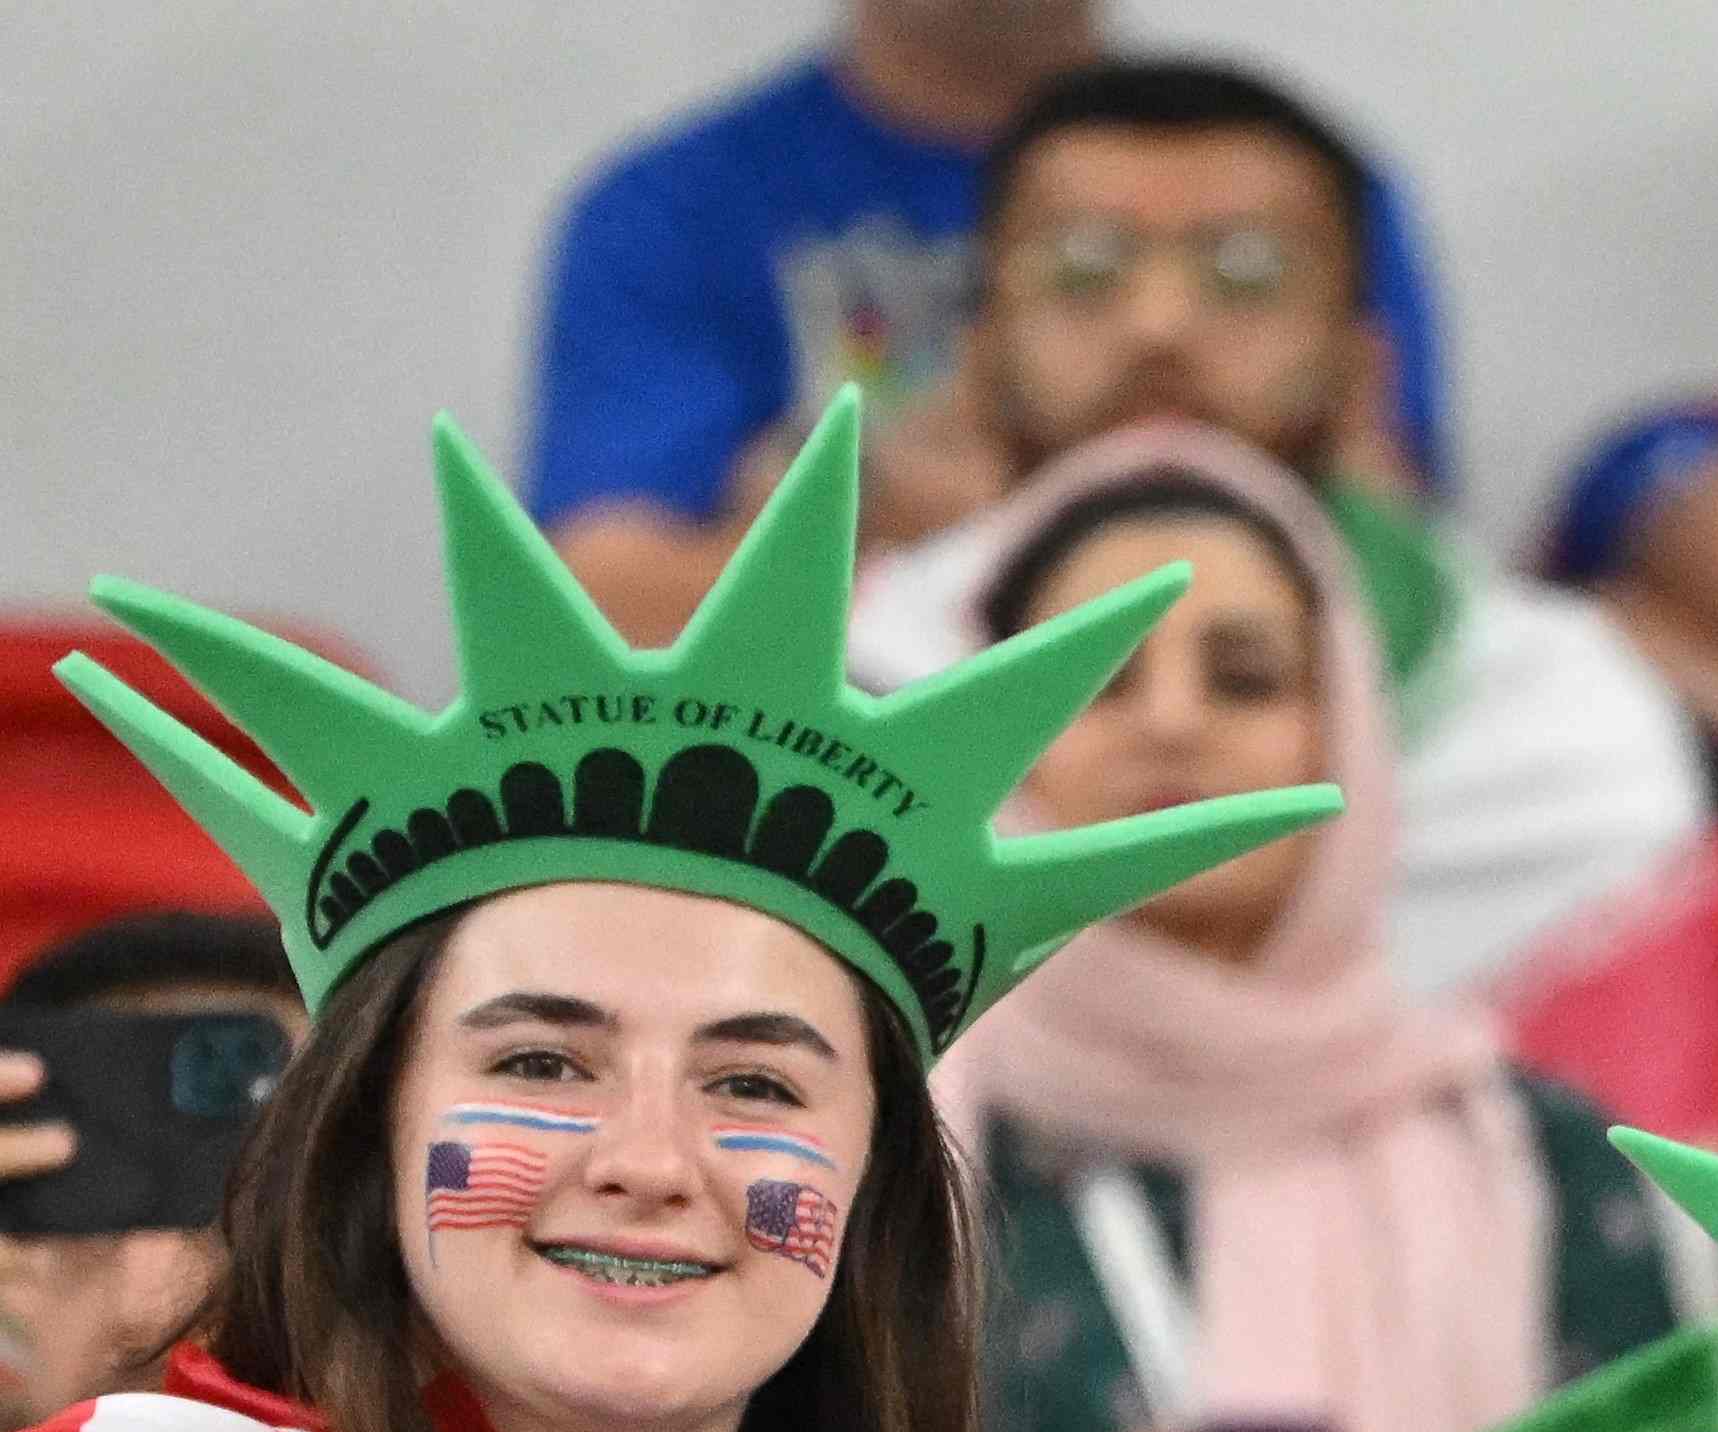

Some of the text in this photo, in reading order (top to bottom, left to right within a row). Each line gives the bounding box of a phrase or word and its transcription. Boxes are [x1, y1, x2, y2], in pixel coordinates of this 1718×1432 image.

[479, 695, 929, 818] STATUE OF LIBERTY
